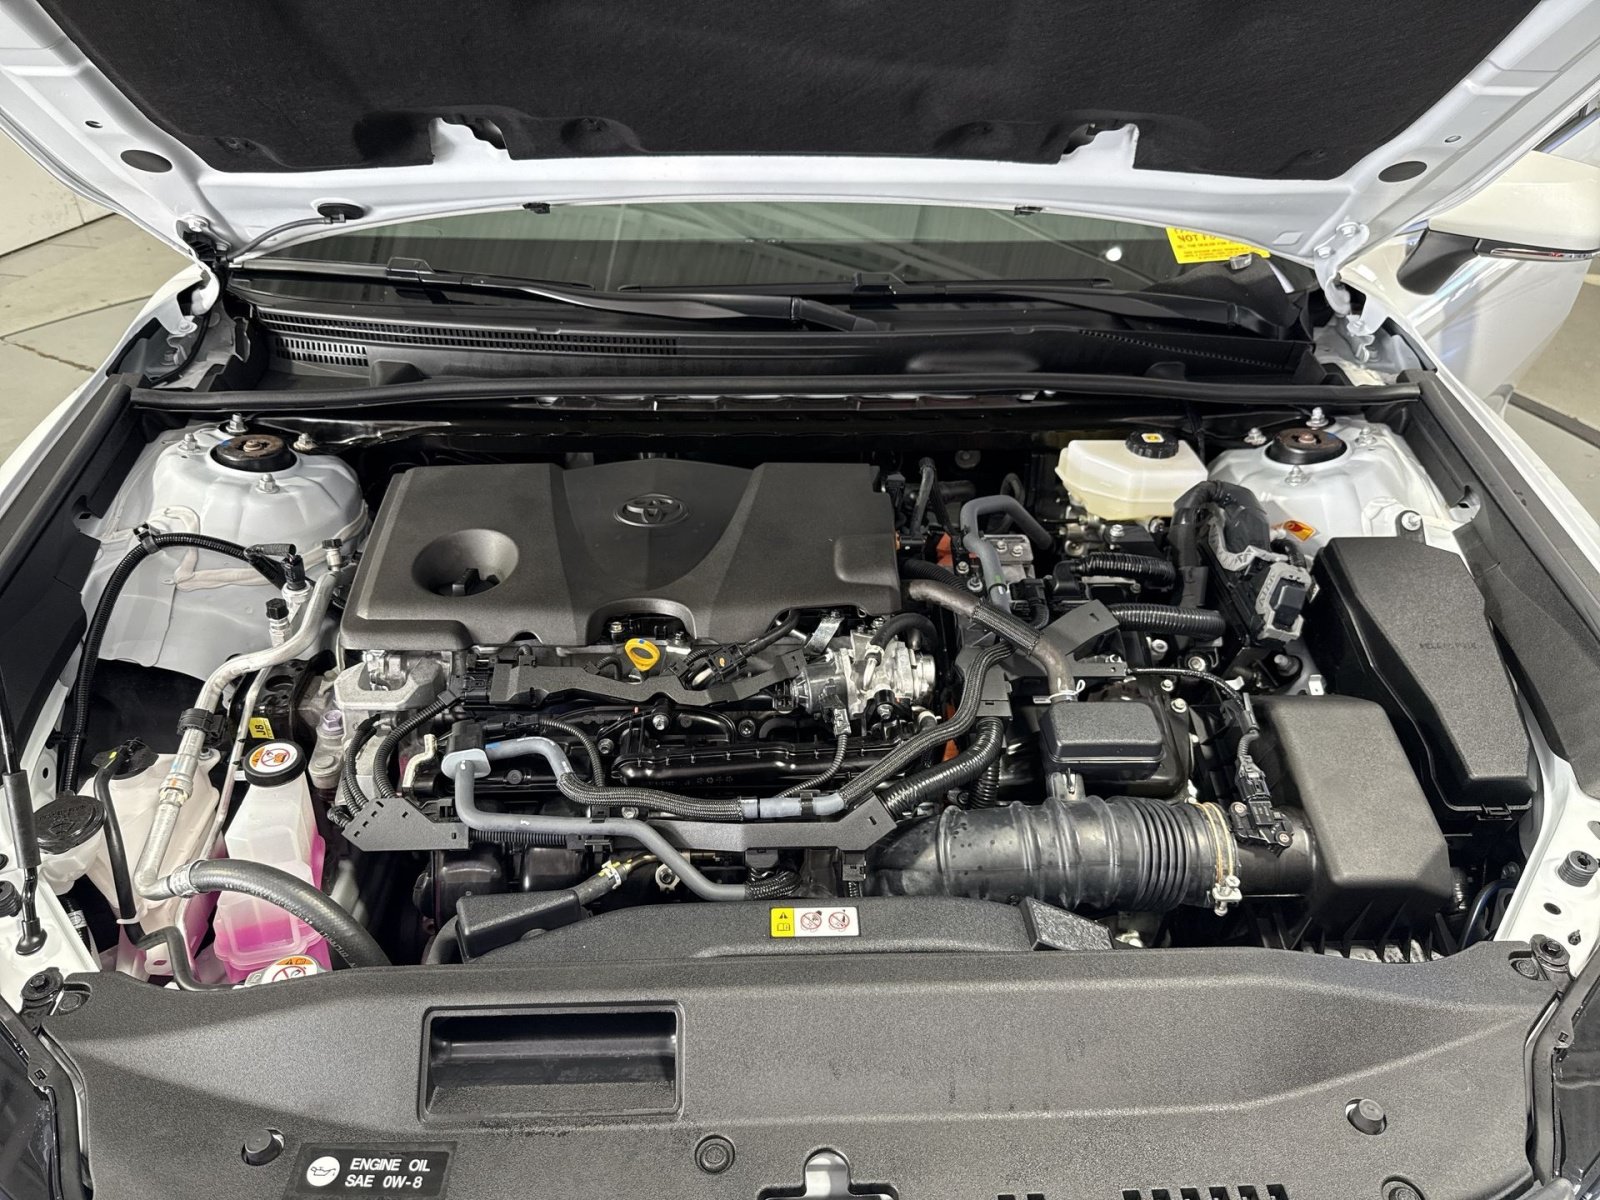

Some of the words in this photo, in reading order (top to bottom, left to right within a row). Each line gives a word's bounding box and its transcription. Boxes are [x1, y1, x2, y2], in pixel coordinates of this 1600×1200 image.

[350, 1158, 402, 1171] ENGINE
[408, 1159, 431, 1172] OIL
[344, 1174, 375, 1188] SAE
[382, 1175, 424, 1189] 0W-8
